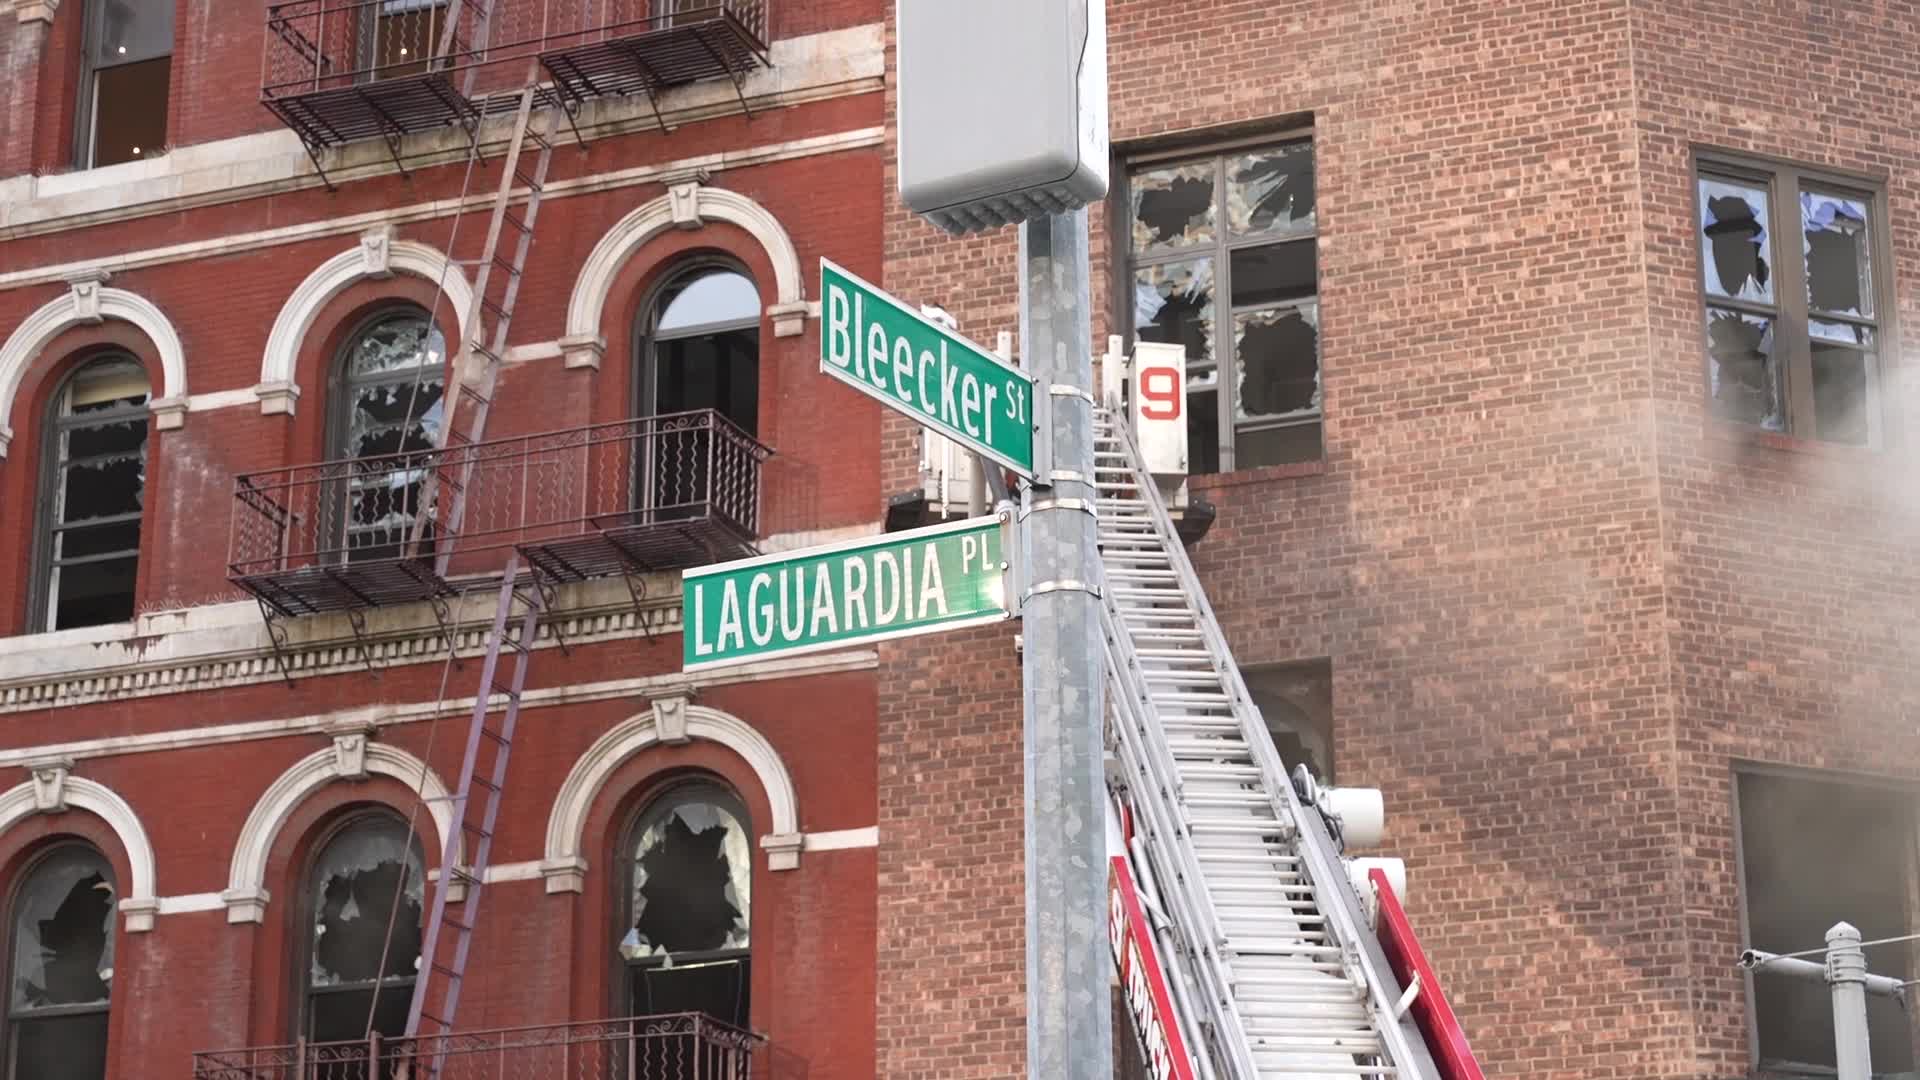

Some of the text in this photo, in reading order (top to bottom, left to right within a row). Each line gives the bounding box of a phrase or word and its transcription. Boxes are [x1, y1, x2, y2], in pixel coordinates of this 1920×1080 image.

[828, 284, 1025, 443] Bleecker St
[1140, 367, 1180, 420] 9
[695, 537, 994, 656] LAGUARDIA PL
